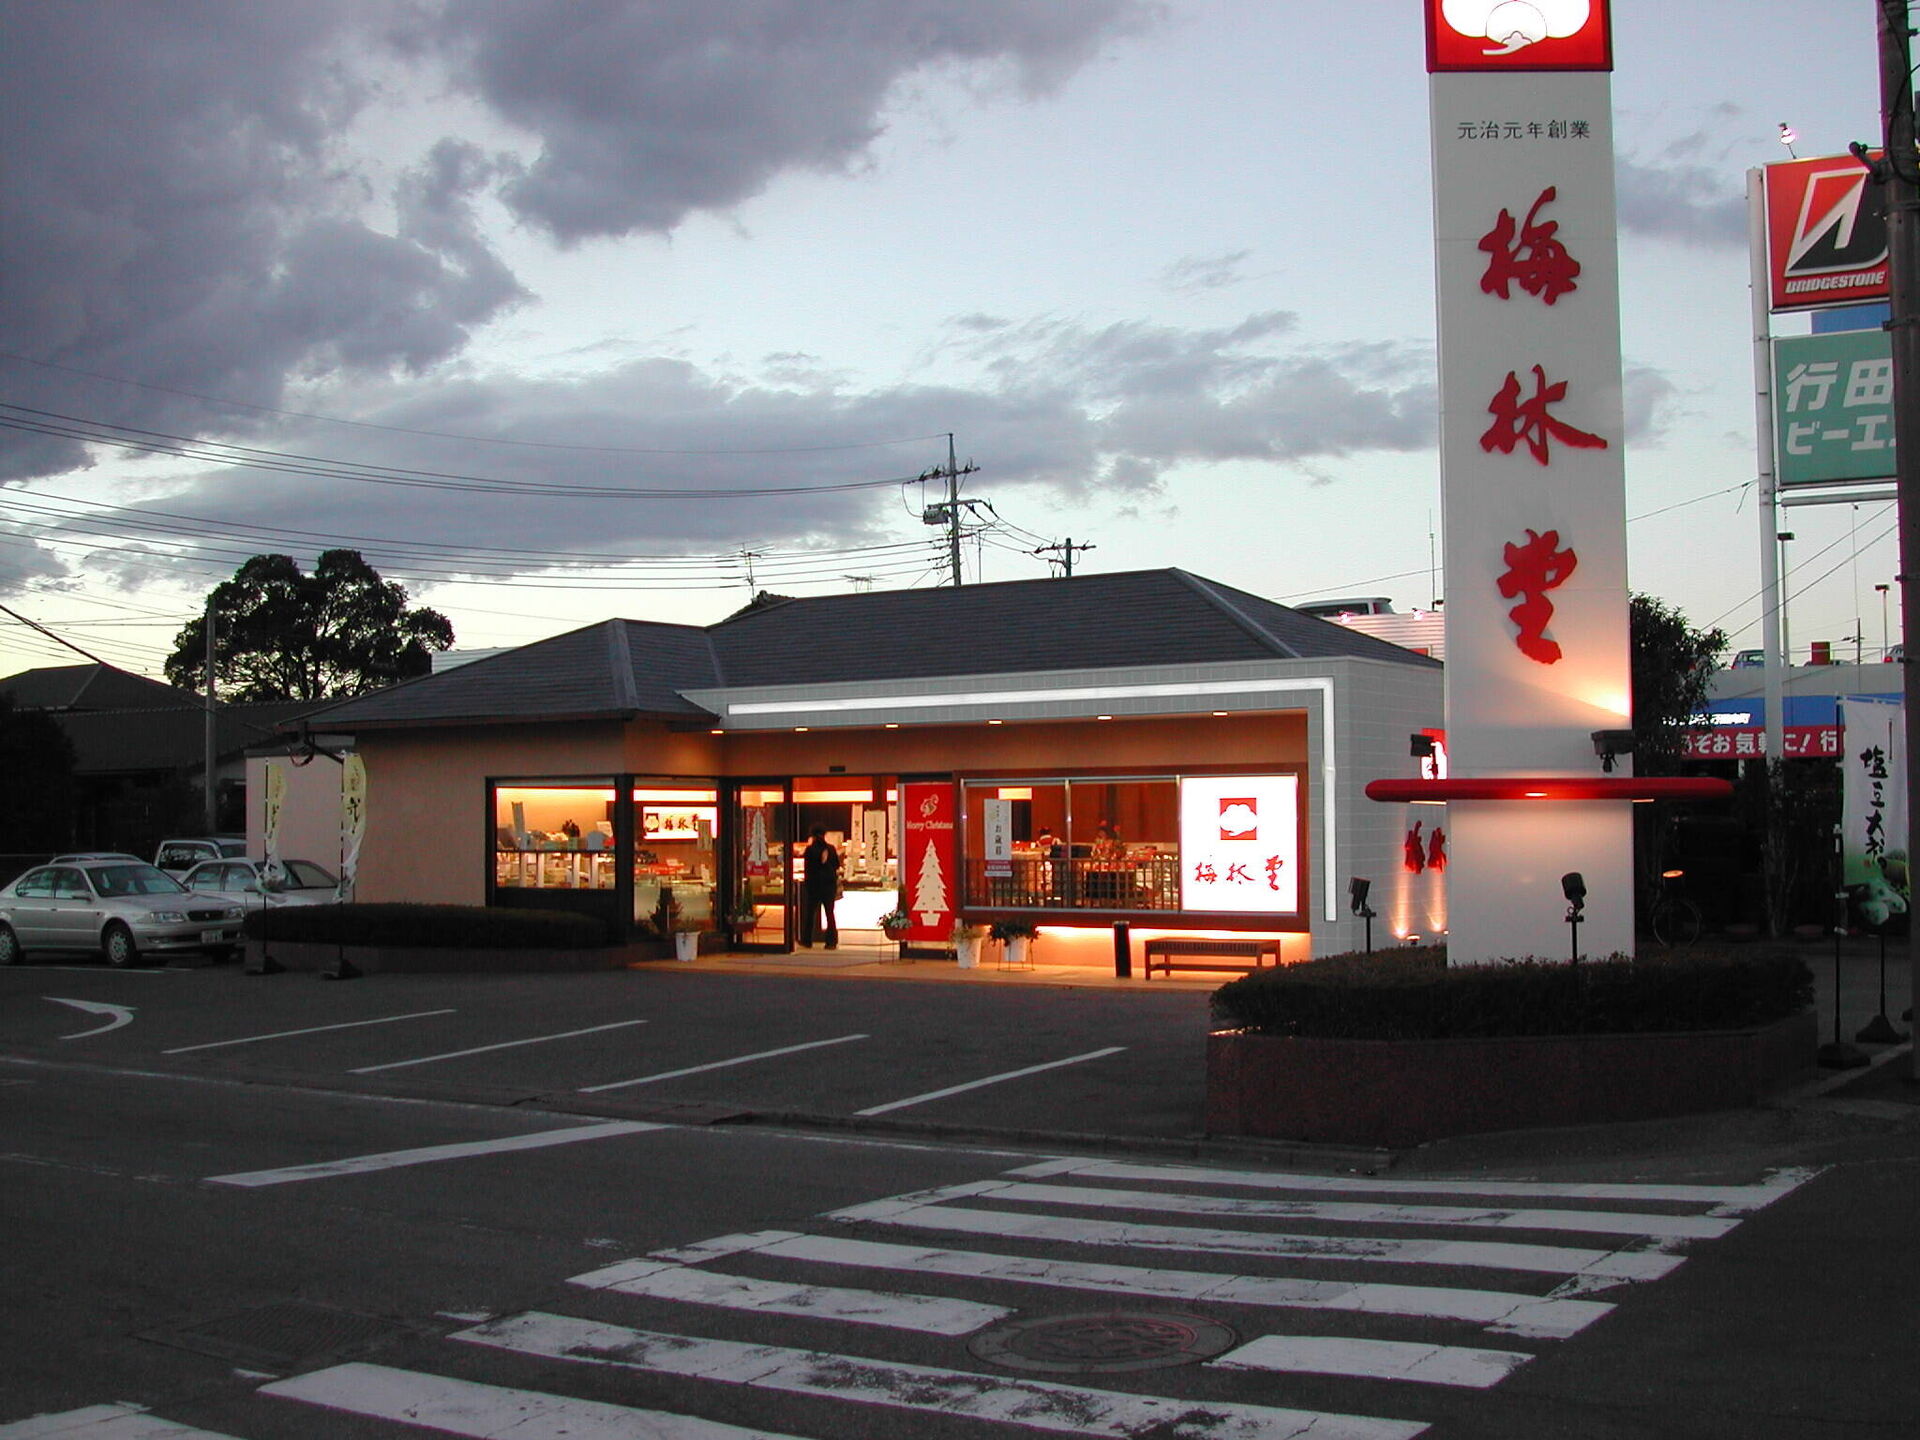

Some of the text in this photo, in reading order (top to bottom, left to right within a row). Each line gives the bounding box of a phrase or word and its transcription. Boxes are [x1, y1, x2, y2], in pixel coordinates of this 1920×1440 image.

[1457, 119, 1591, 140] 元治元年創業
[1785, 271, 1887, 294] BRIDGESTONE
[1785, 357, 1894, 413] 行田
[1478, 186, 1608, 665] 梅林堂
[1786, 414, 1897, 455] ビーエ
[1194, 854, 1284, 891] 梅林堂
